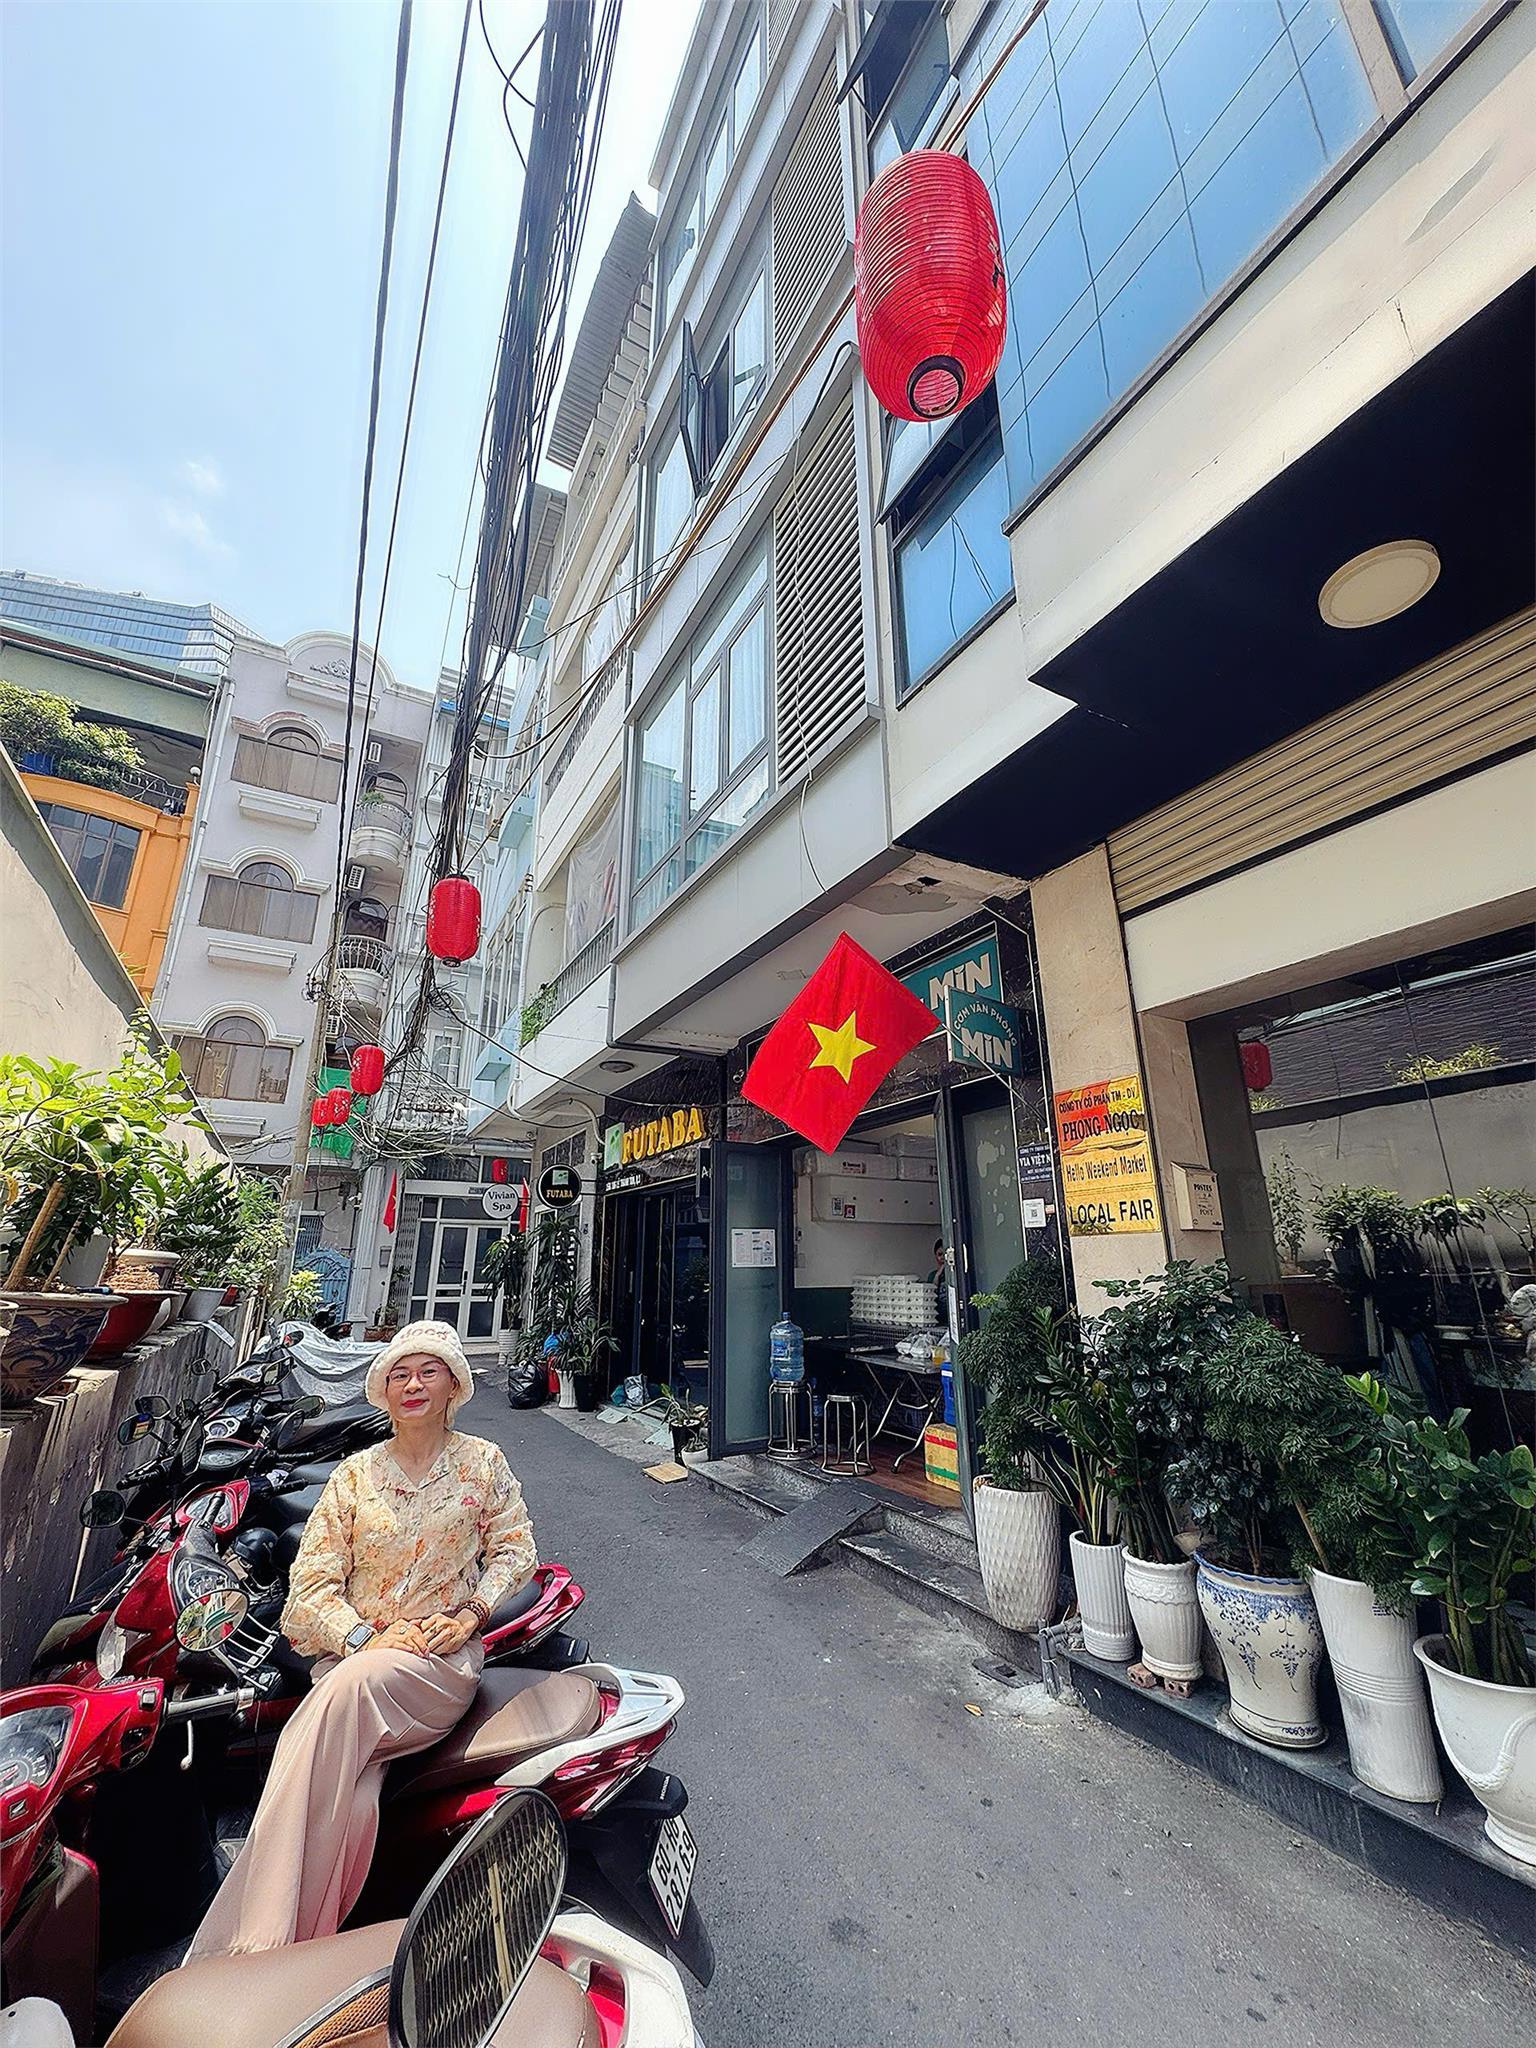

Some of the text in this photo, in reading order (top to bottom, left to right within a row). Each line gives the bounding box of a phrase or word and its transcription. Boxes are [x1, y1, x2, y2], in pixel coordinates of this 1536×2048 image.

[1111, 1090, 1121, 1101] TM
[621, 1107, 704, 1165] FUTABA
[1062, 1109, 1140, 1142] PHONG NGỌC
[1066, 1153, 1148, 1182] Hello Weekend Market
[488, 1190, 515, 1200] Vivian
[492, 1202, 511, 1212] Spa
[546, 1189, 573, 1198] FUTABA
[1069, 1198, 1155, 1225] LOCAL FAIR
[666, 1830, 694, 1930] 287.69
